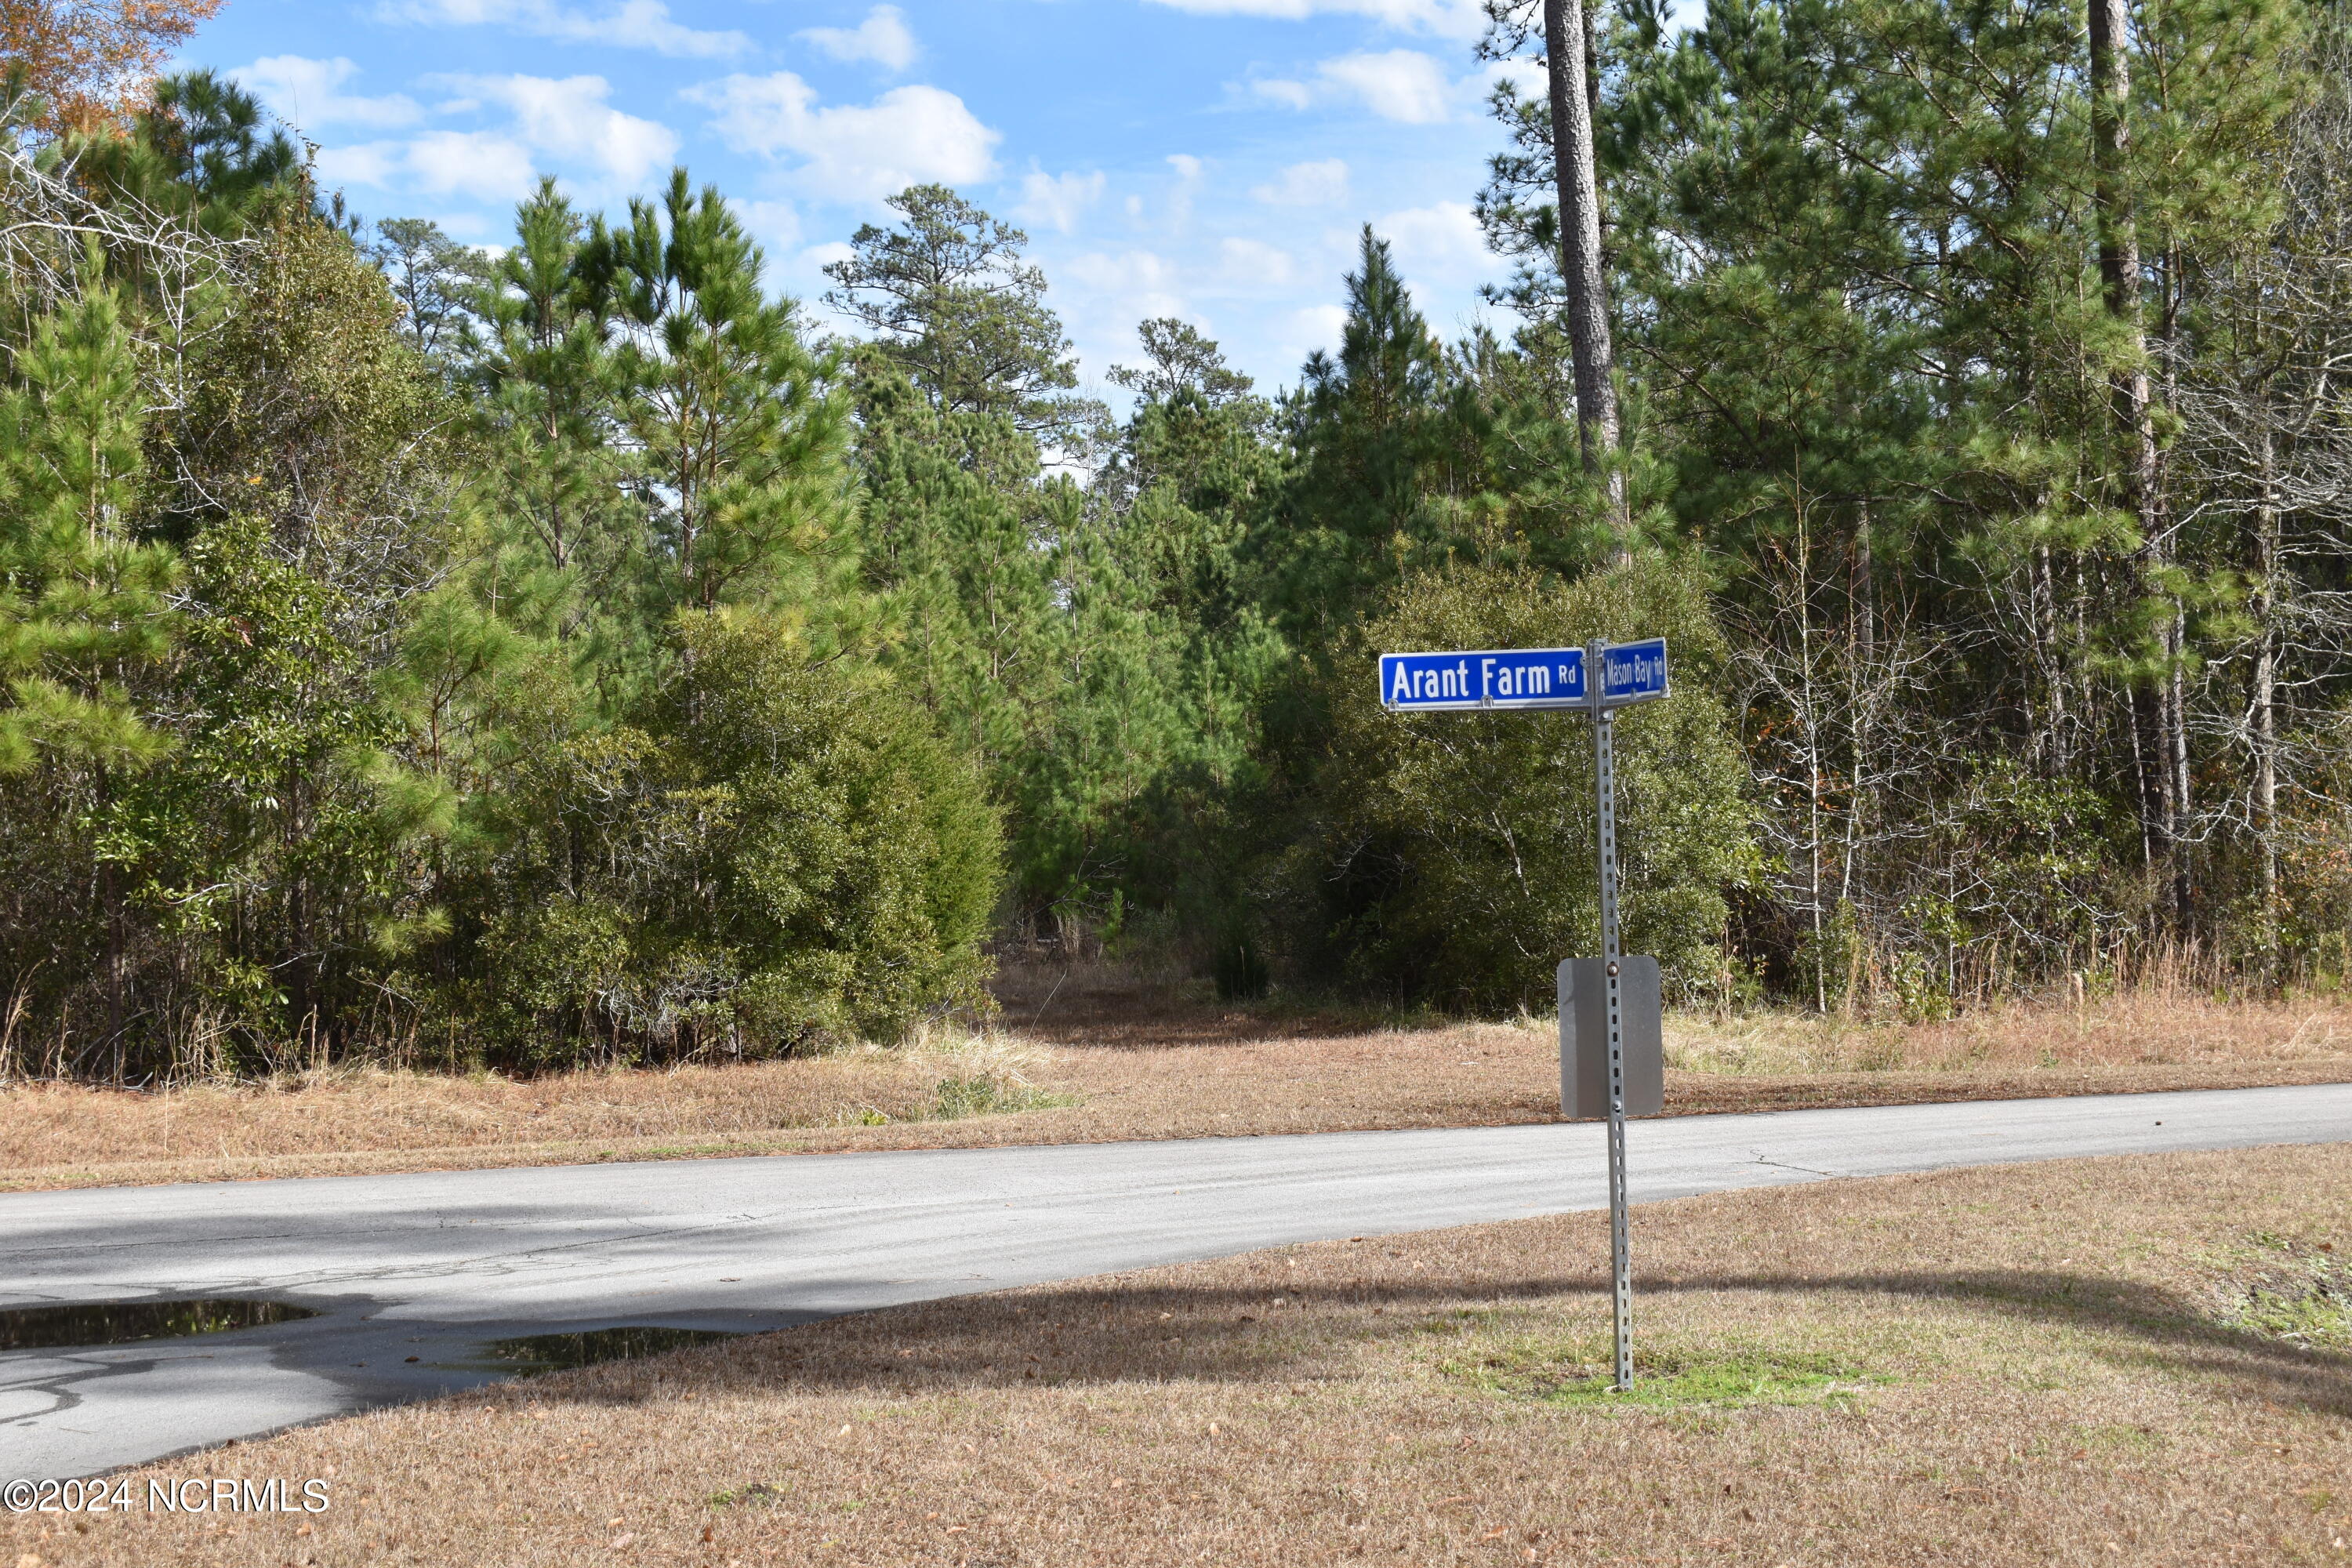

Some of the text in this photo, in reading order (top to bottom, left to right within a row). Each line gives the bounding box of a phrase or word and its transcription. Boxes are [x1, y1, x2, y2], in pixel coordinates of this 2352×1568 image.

[1392, 658, 1577, 699] Arant Farm Rd
[1606, 654, 1662, 689] Mason Bay Rd
